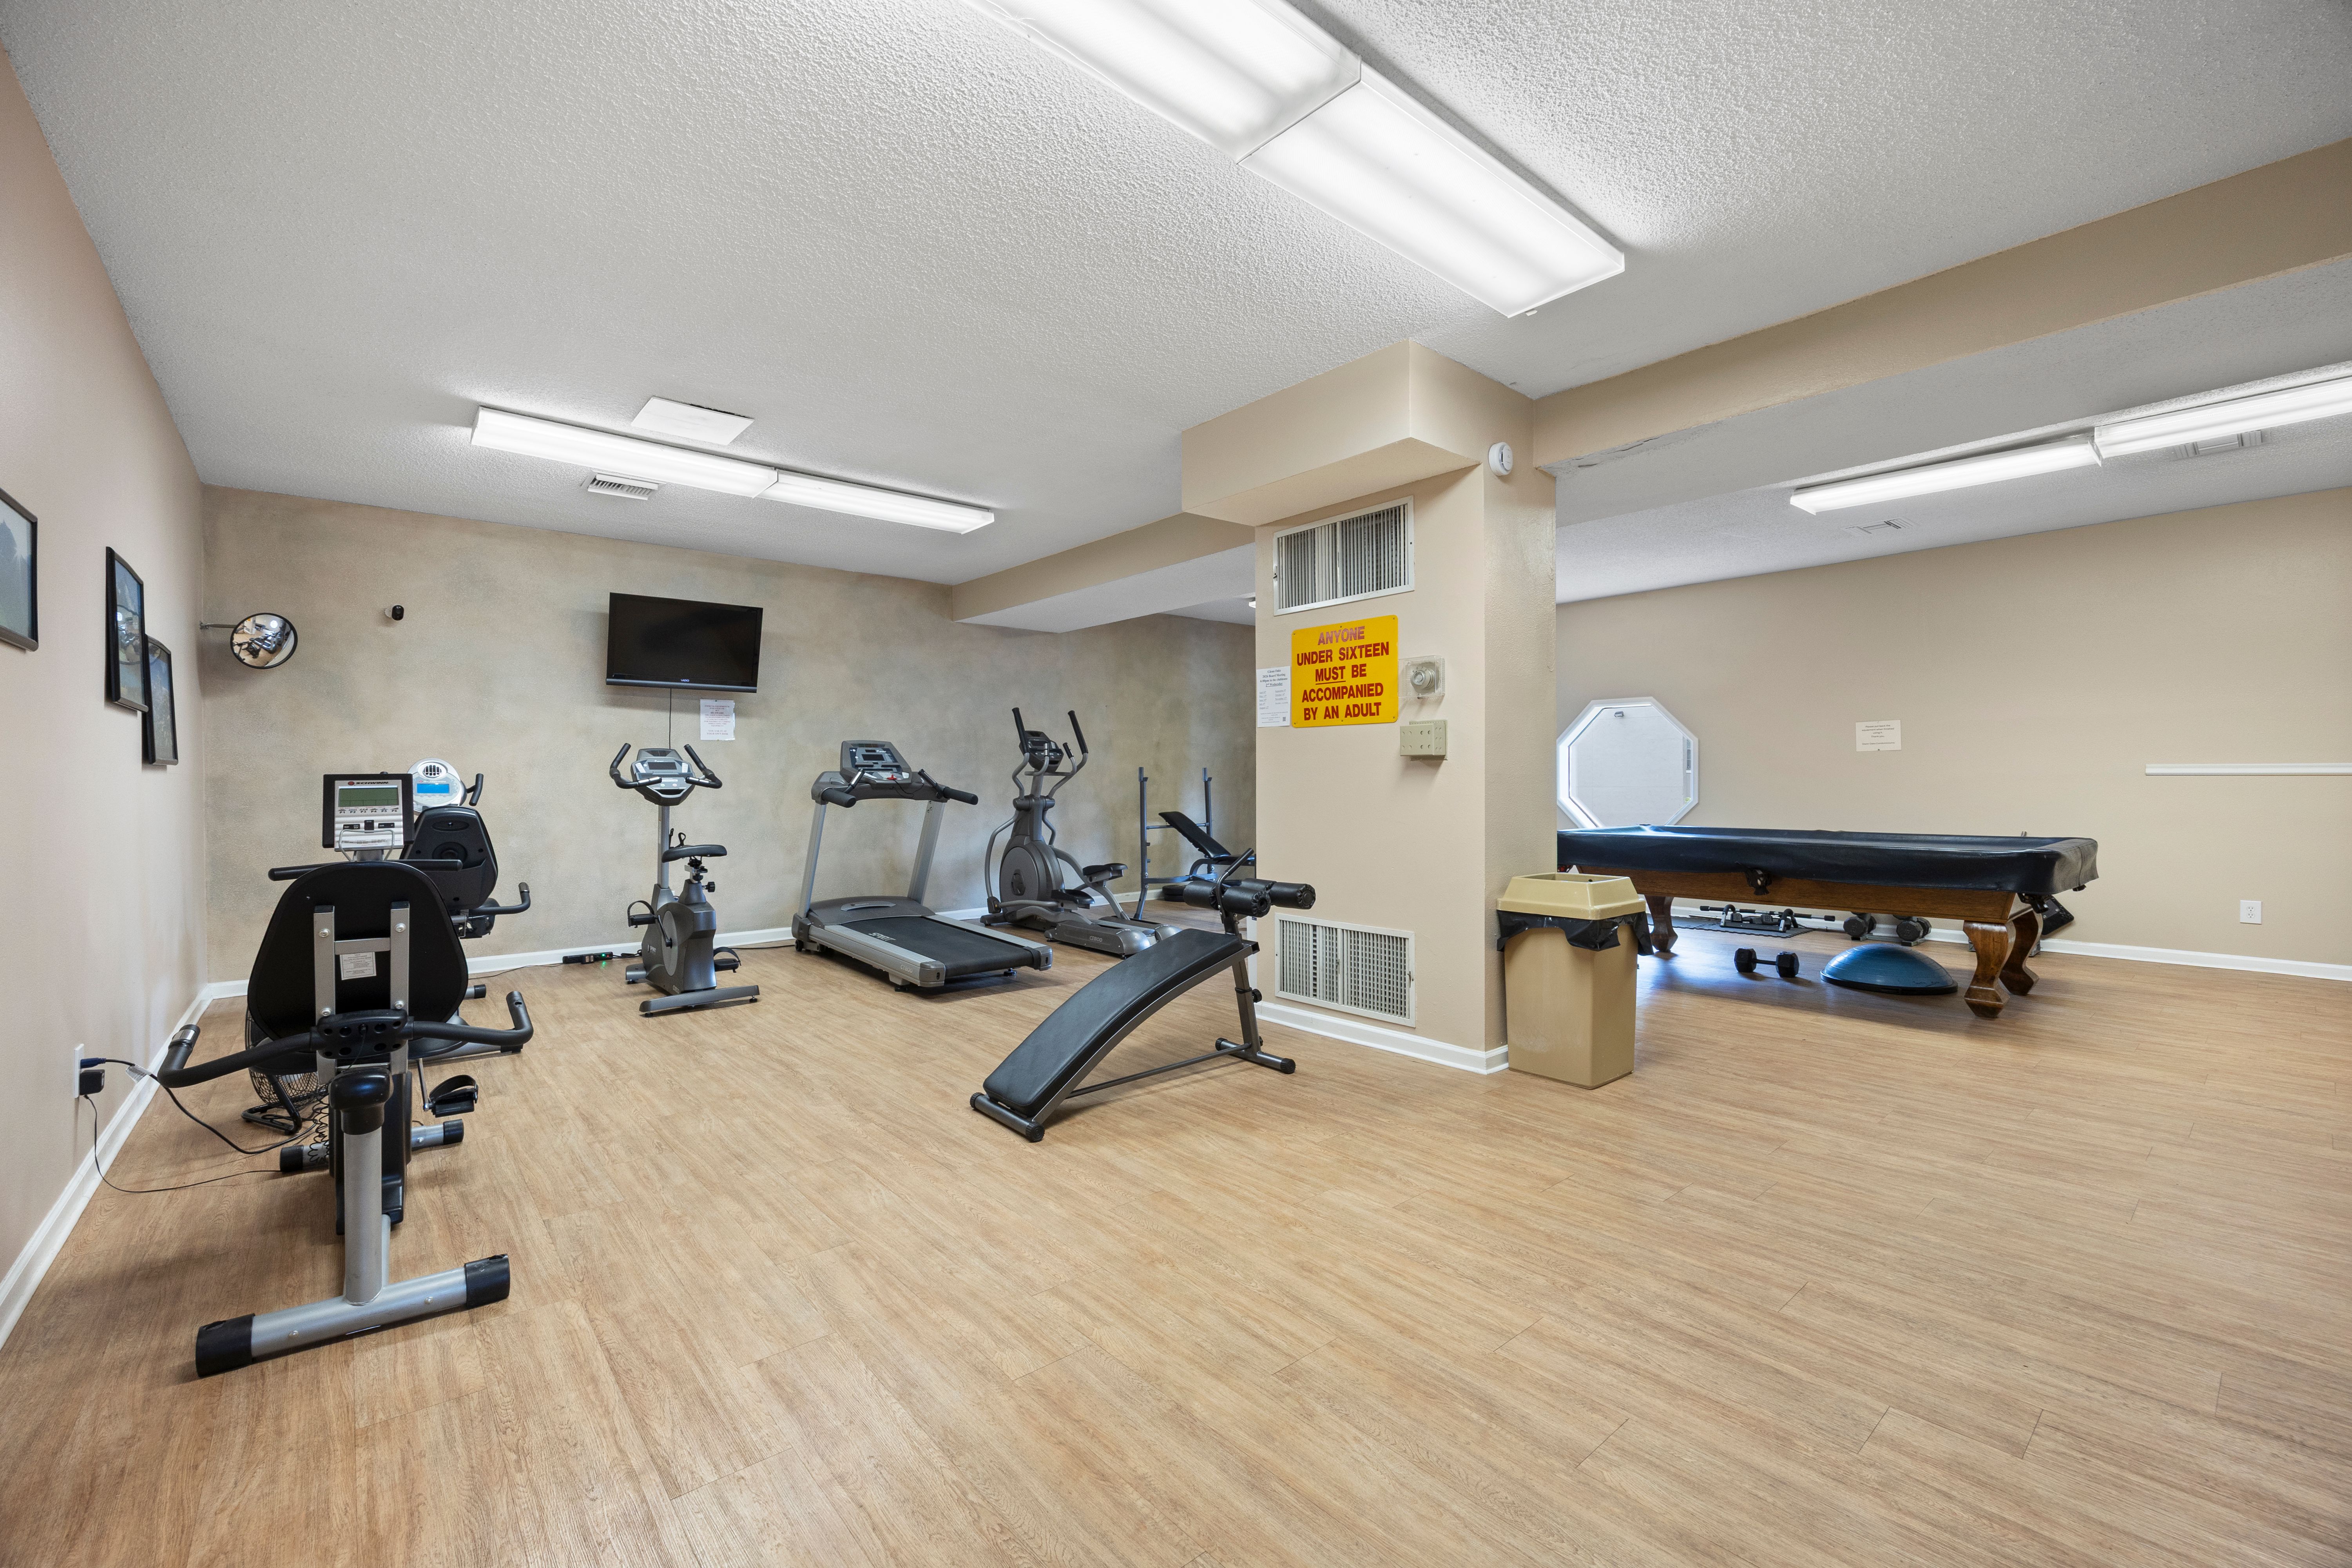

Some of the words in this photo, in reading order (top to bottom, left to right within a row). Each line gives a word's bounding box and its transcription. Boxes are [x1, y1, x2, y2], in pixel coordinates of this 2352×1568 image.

[1317, 626, 1365, 645] ANYONE
[1297, 649, 1333, 666] UNDER
[1339, 642, 1389, 661] SIXTEEN
[1315, 666, 1346, 681] MUST
[1351, 663, 1367, 678] BE
[1302, 682, 1383, 703] ACCOMPANIED
[1304, 707, 1318, 721] BY
[1324, 705, 1339, 719] AN
[1345, 702, 1381, 718] ADULT
[900, 964, 913, 973] CT800
